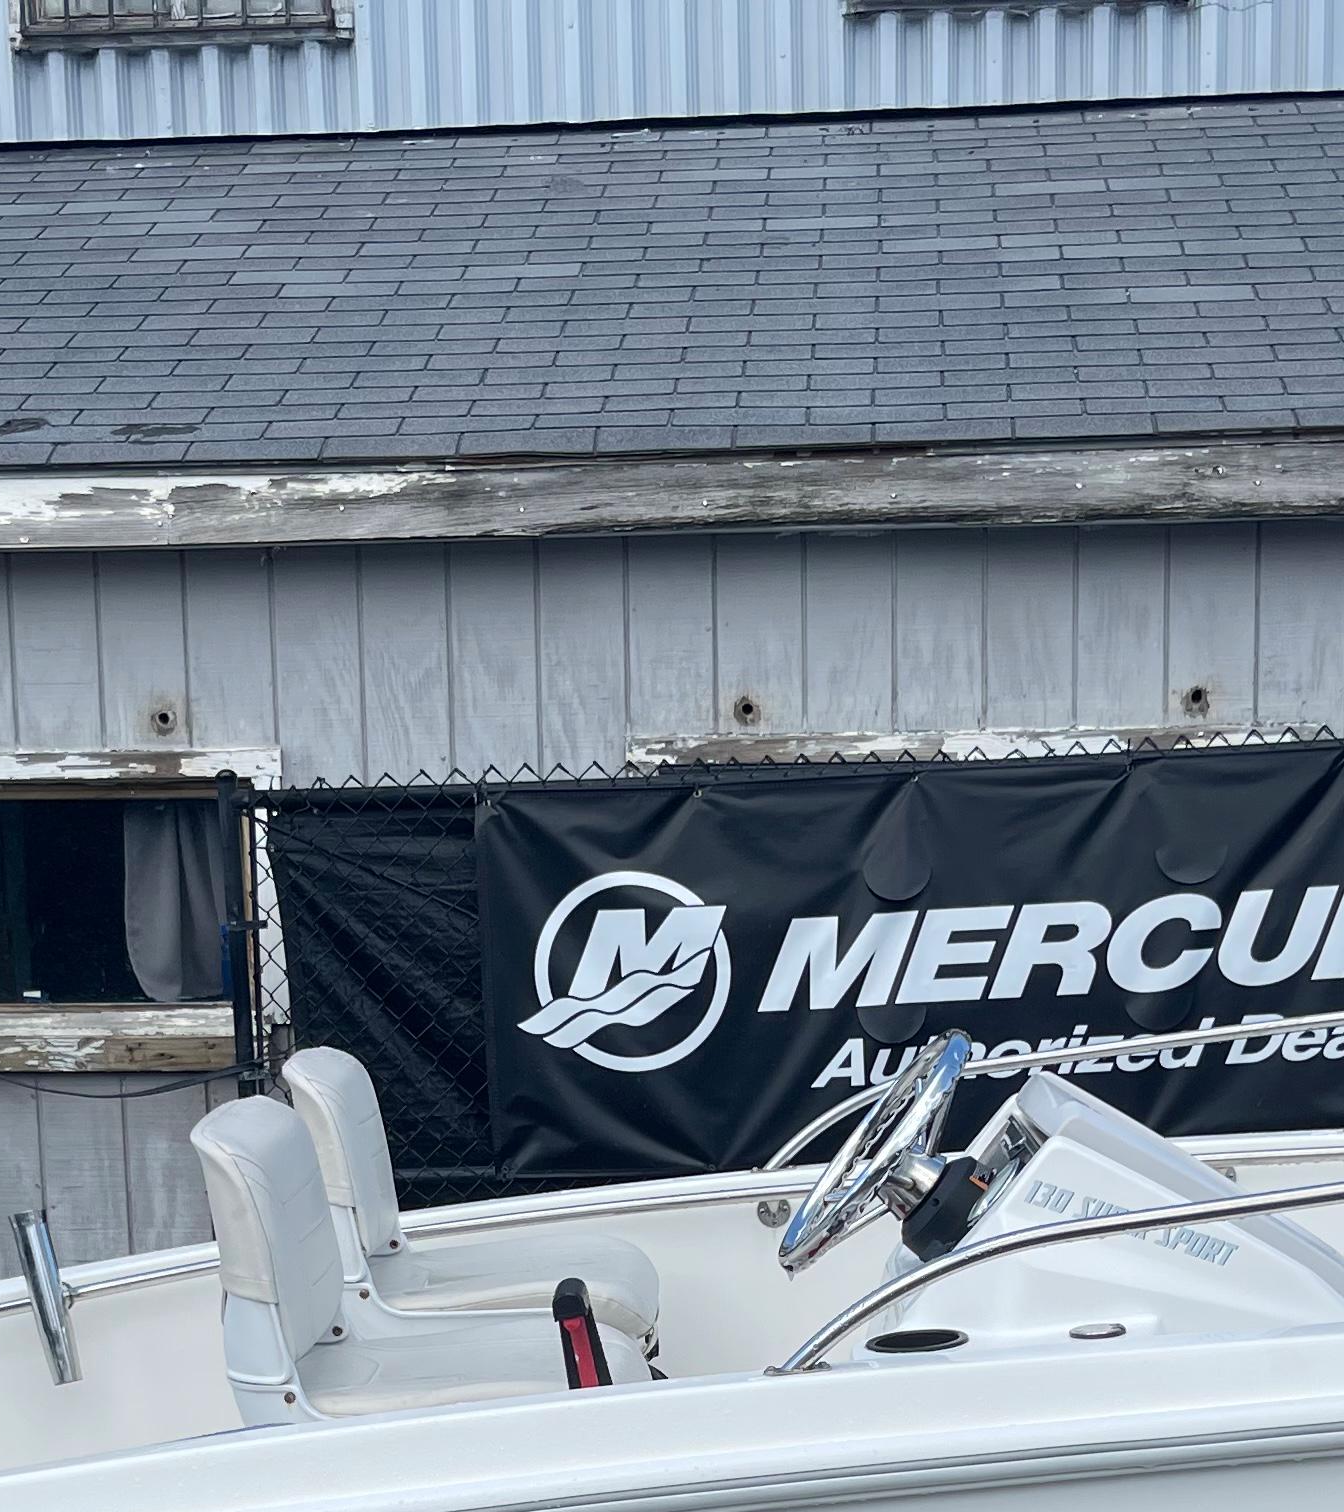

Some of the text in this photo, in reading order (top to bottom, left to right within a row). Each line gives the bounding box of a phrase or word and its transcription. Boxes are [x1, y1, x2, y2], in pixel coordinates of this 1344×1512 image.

[810, 1016, 1216, 1089] Auorized
[1024, 1180, 1240, 1266] 130 SPORT
